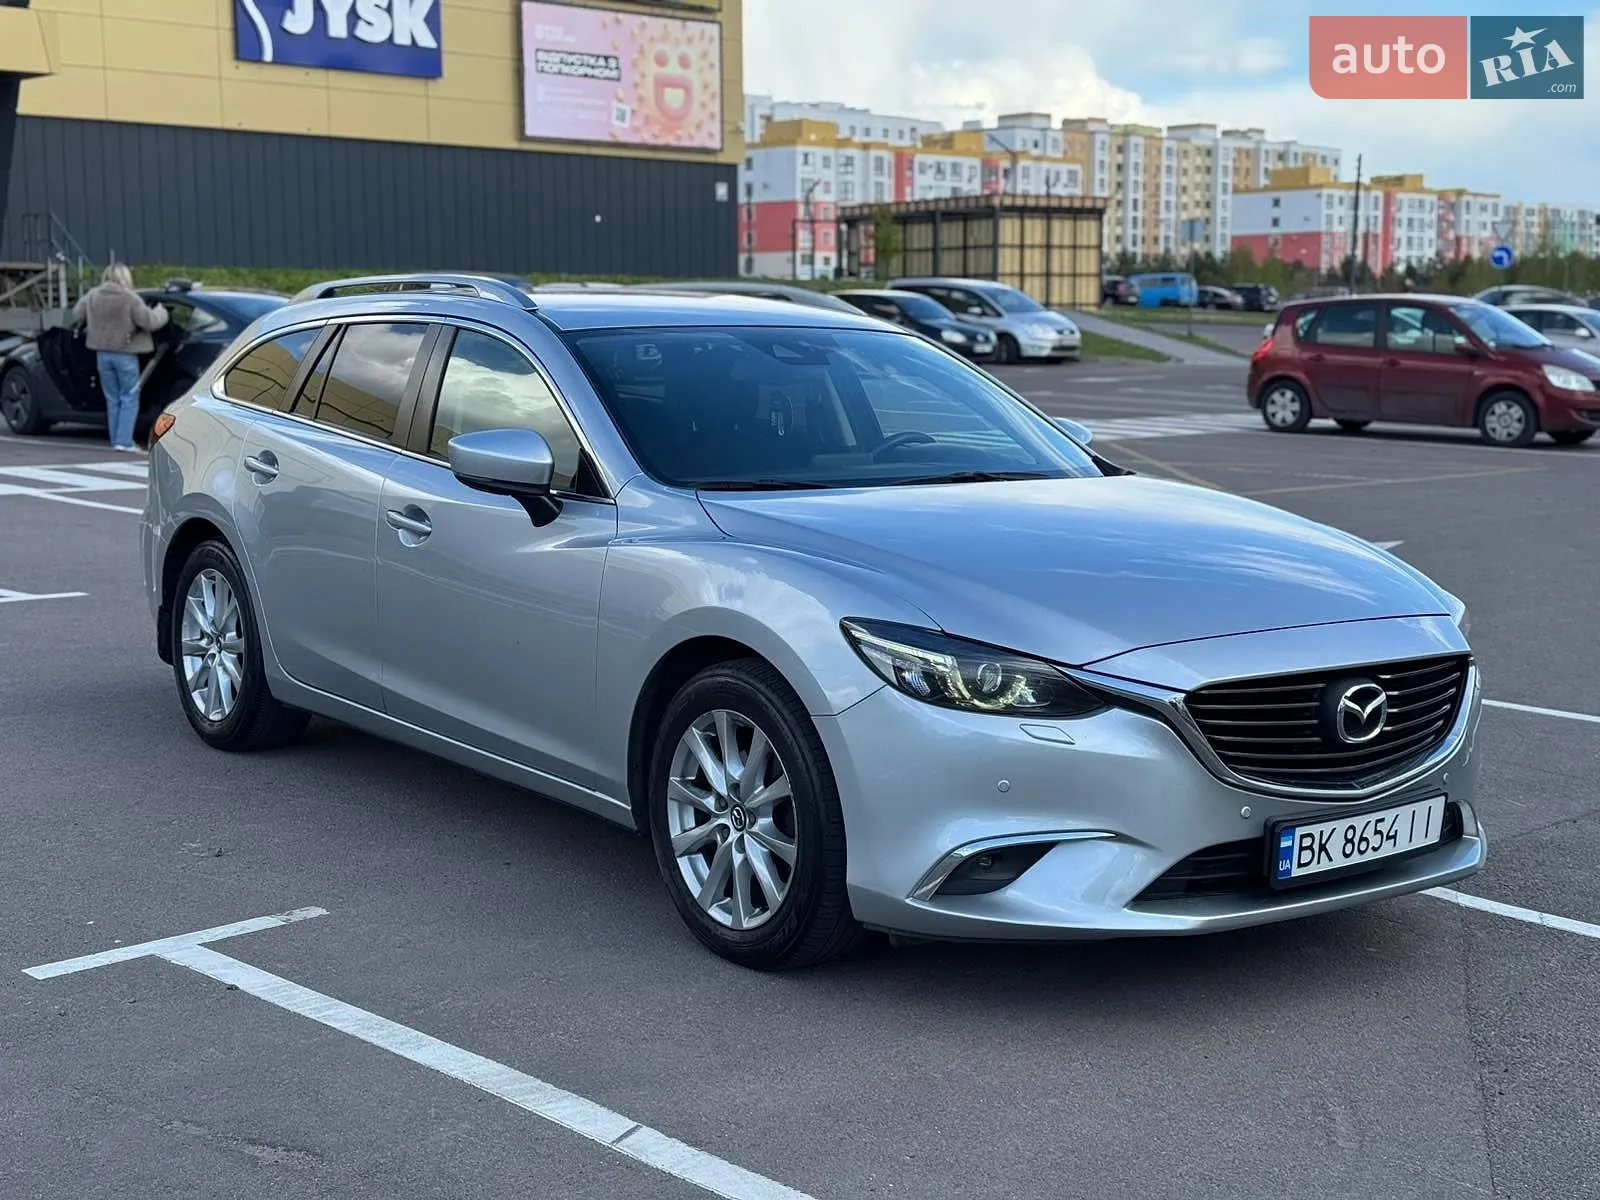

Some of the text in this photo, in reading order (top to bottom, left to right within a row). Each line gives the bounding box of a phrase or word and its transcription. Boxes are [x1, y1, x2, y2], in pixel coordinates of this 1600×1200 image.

[281, 0, 438, 48] JYSK
[1296, 827, 1336, 868] BK
[1342, 814, 1399, 858] 8654
[1279, 860, 1291, 871] UA
